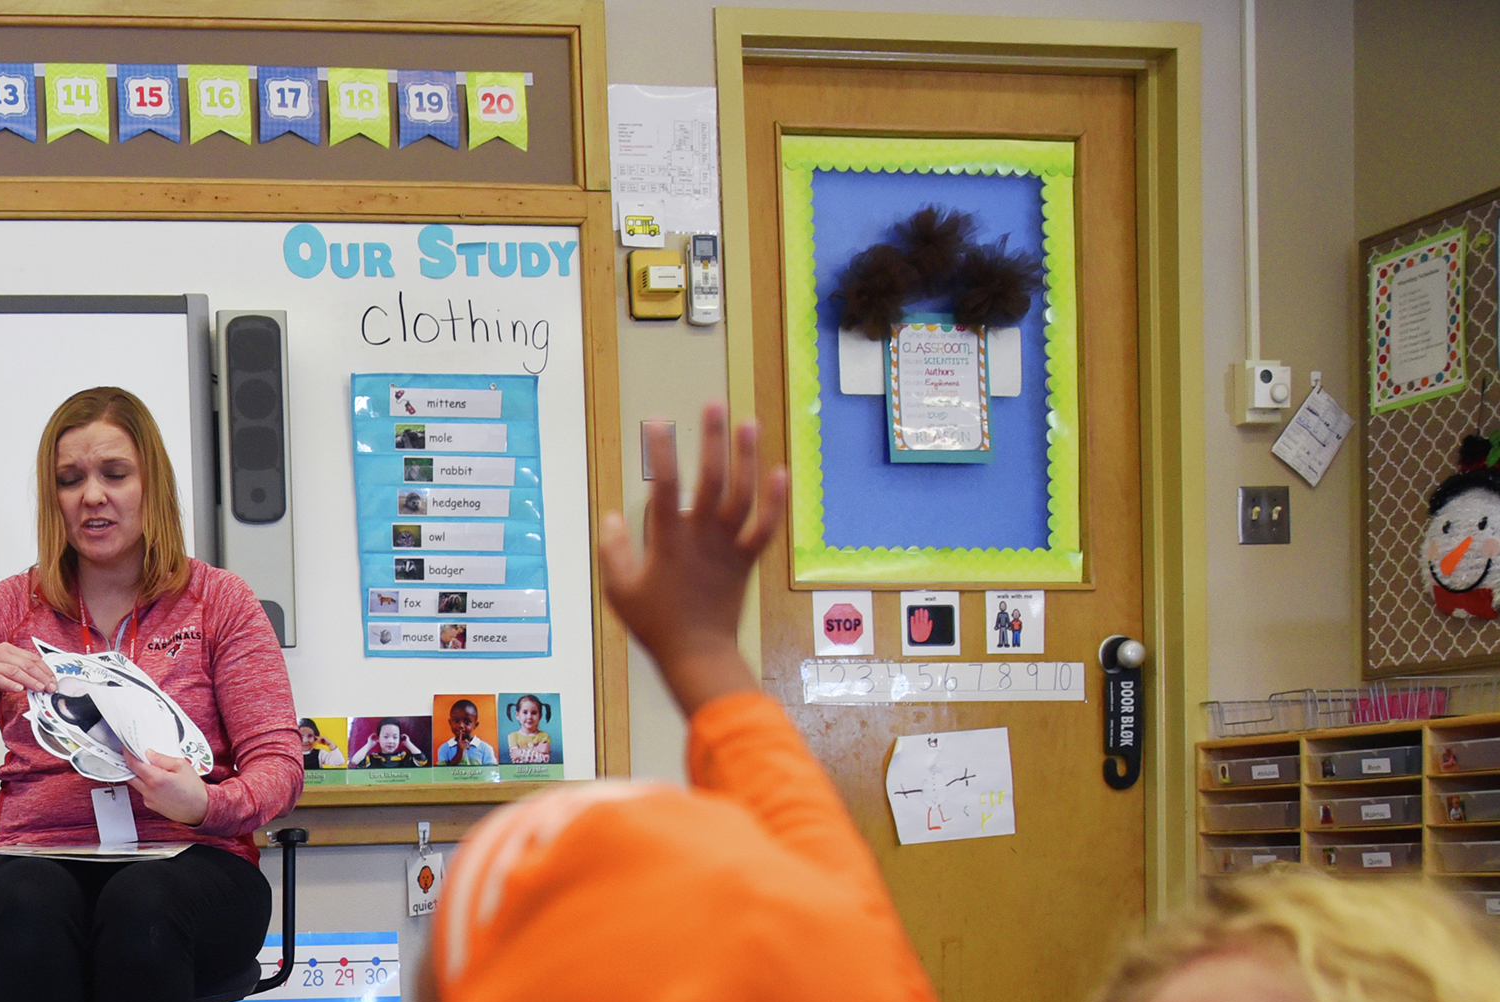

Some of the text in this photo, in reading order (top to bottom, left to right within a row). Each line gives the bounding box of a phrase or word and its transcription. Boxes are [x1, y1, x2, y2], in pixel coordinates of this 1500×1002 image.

[63, 84, 93, 107] 14
[135, 85, 164, 108] 15
[206, 85, 234, 108] 16
[277, 87, 302, 109] 17
[346, 89, 375, 111] 18
[415, 91, 444, 113] 19
[481, 92, 515, 115] 20
[283, 224, 577, 279] OUR STUDY
[427, 398, 466, 409] mittens
[429, 433, 453, 443] mole
[440, 466, 472, 477] rabbit
[432, 498, 481, 510] hedgehog
[429, 532, 445, 542] owl
[429, 564, 464, 576] badger
[403, 598, 494, 609] fox bear
[826, 619, 861, 632] STOP
[402, 633, 508, 643] mouse sneeze
[857, 665, 875, 693] 3
[886, 664, 903, 688] 4
[918, 664, 934, 691] 5
[944, 664, 958, 691] 6
[969, 664, 983, 691] 7
[999, 664, 1012, 690] 8
[1026, 664, 1039, 691] 9
[1054, 664, 1073, 691] 10
[1120, 681, 1135, 713] DOOR
[302, 970, 324, 987] 28
[334, 969, 355, 986] 29
[365, 968, 388, 985] 30
